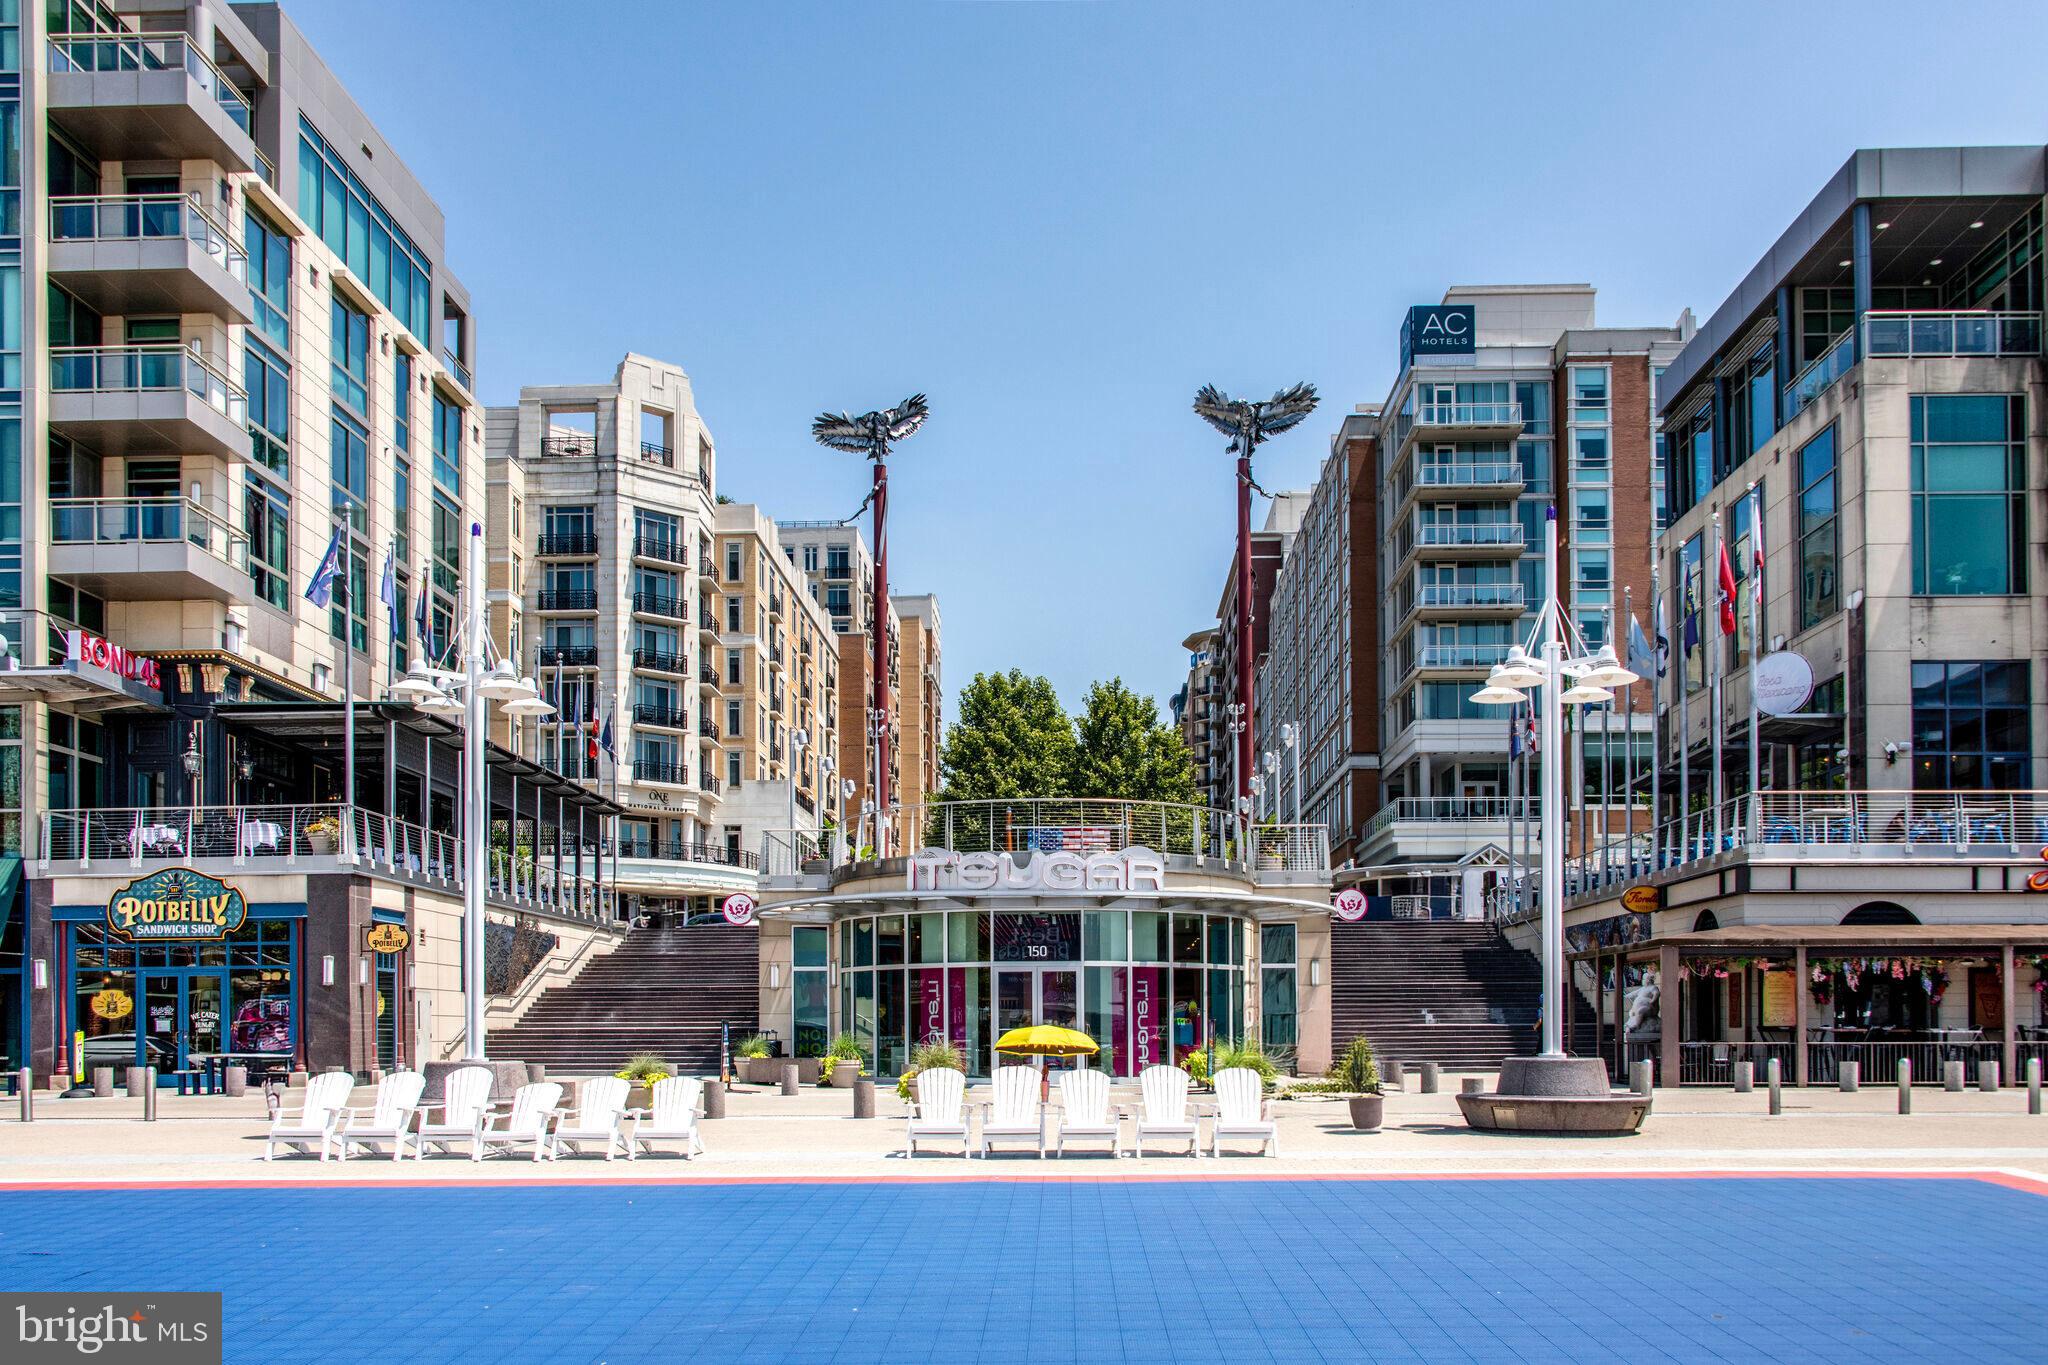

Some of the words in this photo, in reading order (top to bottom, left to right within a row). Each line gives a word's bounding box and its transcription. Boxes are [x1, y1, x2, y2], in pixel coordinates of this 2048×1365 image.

[1422, 312, 1467, 335] AC
[80, 630, 136, 680] BOND
[140, 658, 161, 691] 45
[648, 789, 669, 805] ONE
[628, 803, 661, 811] NATIONAL
[116, 893, 232, 928] POTBELLY
[137, 924, 188, 934] SANDWICH
[190, 924, 217, 934] SHOP
[1027, 945, 1048, 957] 150
[201, 1011, 220, 1020] CATER
